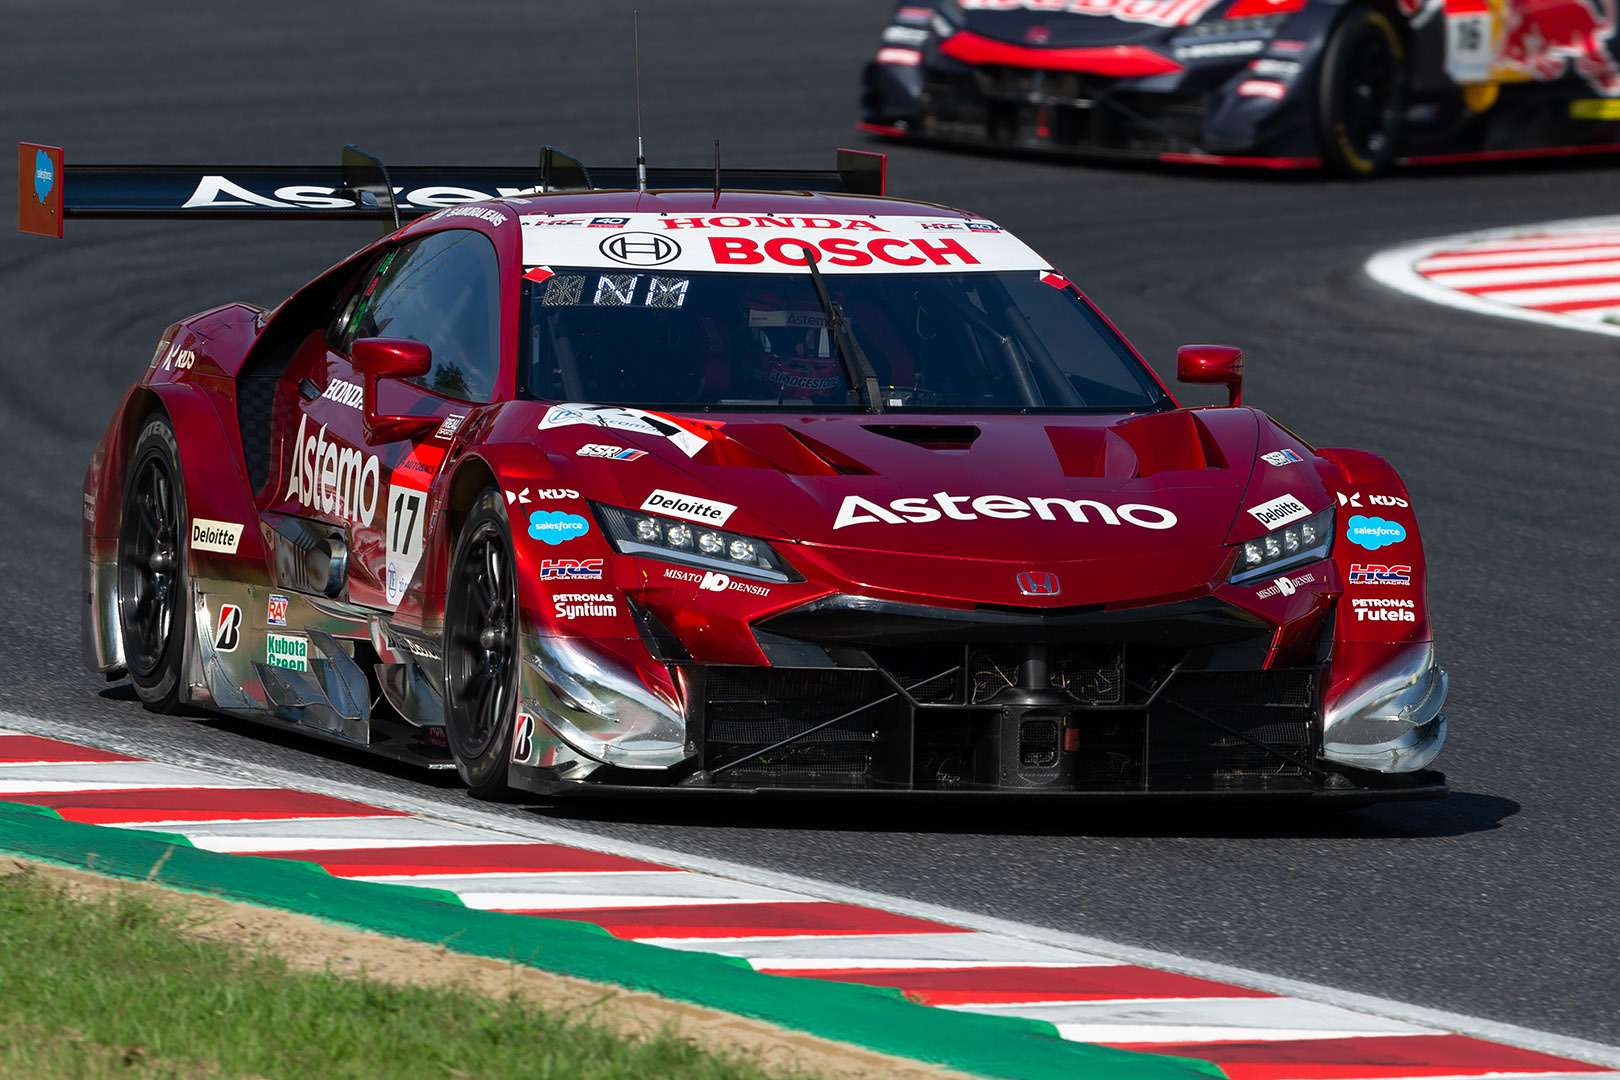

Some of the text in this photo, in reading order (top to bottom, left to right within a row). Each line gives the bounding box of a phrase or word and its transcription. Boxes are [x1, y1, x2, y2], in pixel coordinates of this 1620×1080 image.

[657, 216, 891, 233] HONDA
[708, 237, 981, 267] BOSCH
[577, 444, 621, 459] SSR
[284, 413, 380, 528] Astemo
[833, 491, 1178, 530] Astemo
[394, 493, 420, 555] 17
[535, 521, 583, 531] salesforce
[1353, 526, 1401, 537] salesforce
[540, 559, 604, 577] HRC
[1349, 564, 1411, 581] HRC
[664, 569, 703, 583] MISATO
[729, 582, 770, 597] DENSHI
[552, 594, 614, 602] PETRONAS
[1256, 585, 1280, 600] MISATO
[555, 602, 617, 620] Syntium
[1352, 599, 1415, 608] PETRONAS
[1354, 608, 1415, 622] Tutela
[268, 636, 306, 657] Kubota
